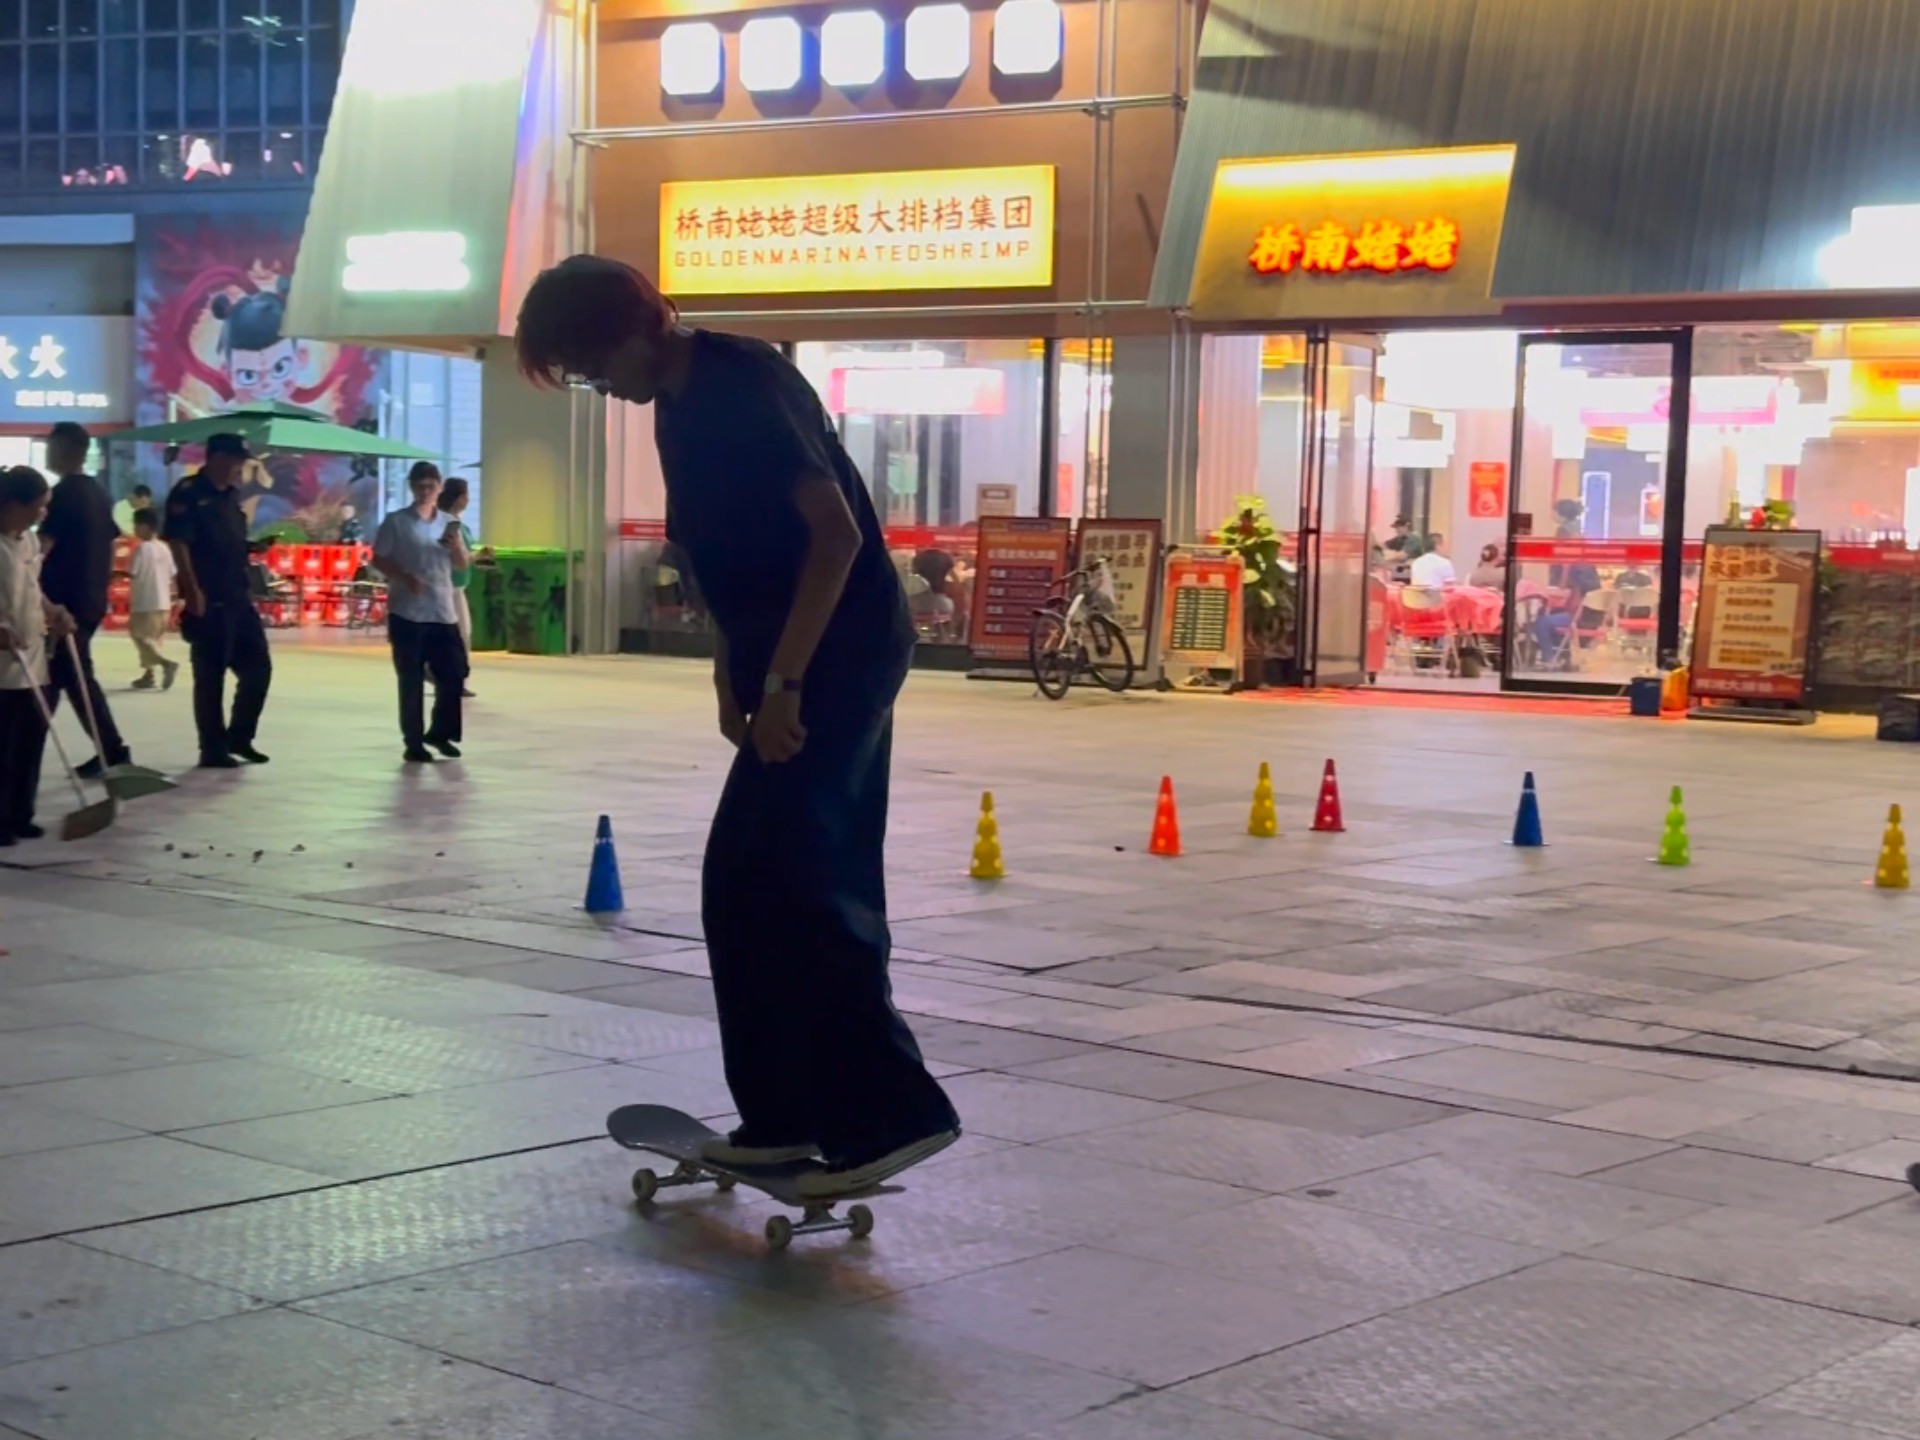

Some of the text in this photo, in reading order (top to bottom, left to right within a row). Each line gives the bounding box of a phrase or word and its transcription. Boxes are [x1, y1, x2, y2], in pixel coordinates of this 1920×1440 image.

[675, 195, 1033, 240] 桥南姥姥超级大排档集团
[1248, 216, 1457, 273] 桥南姥姥
